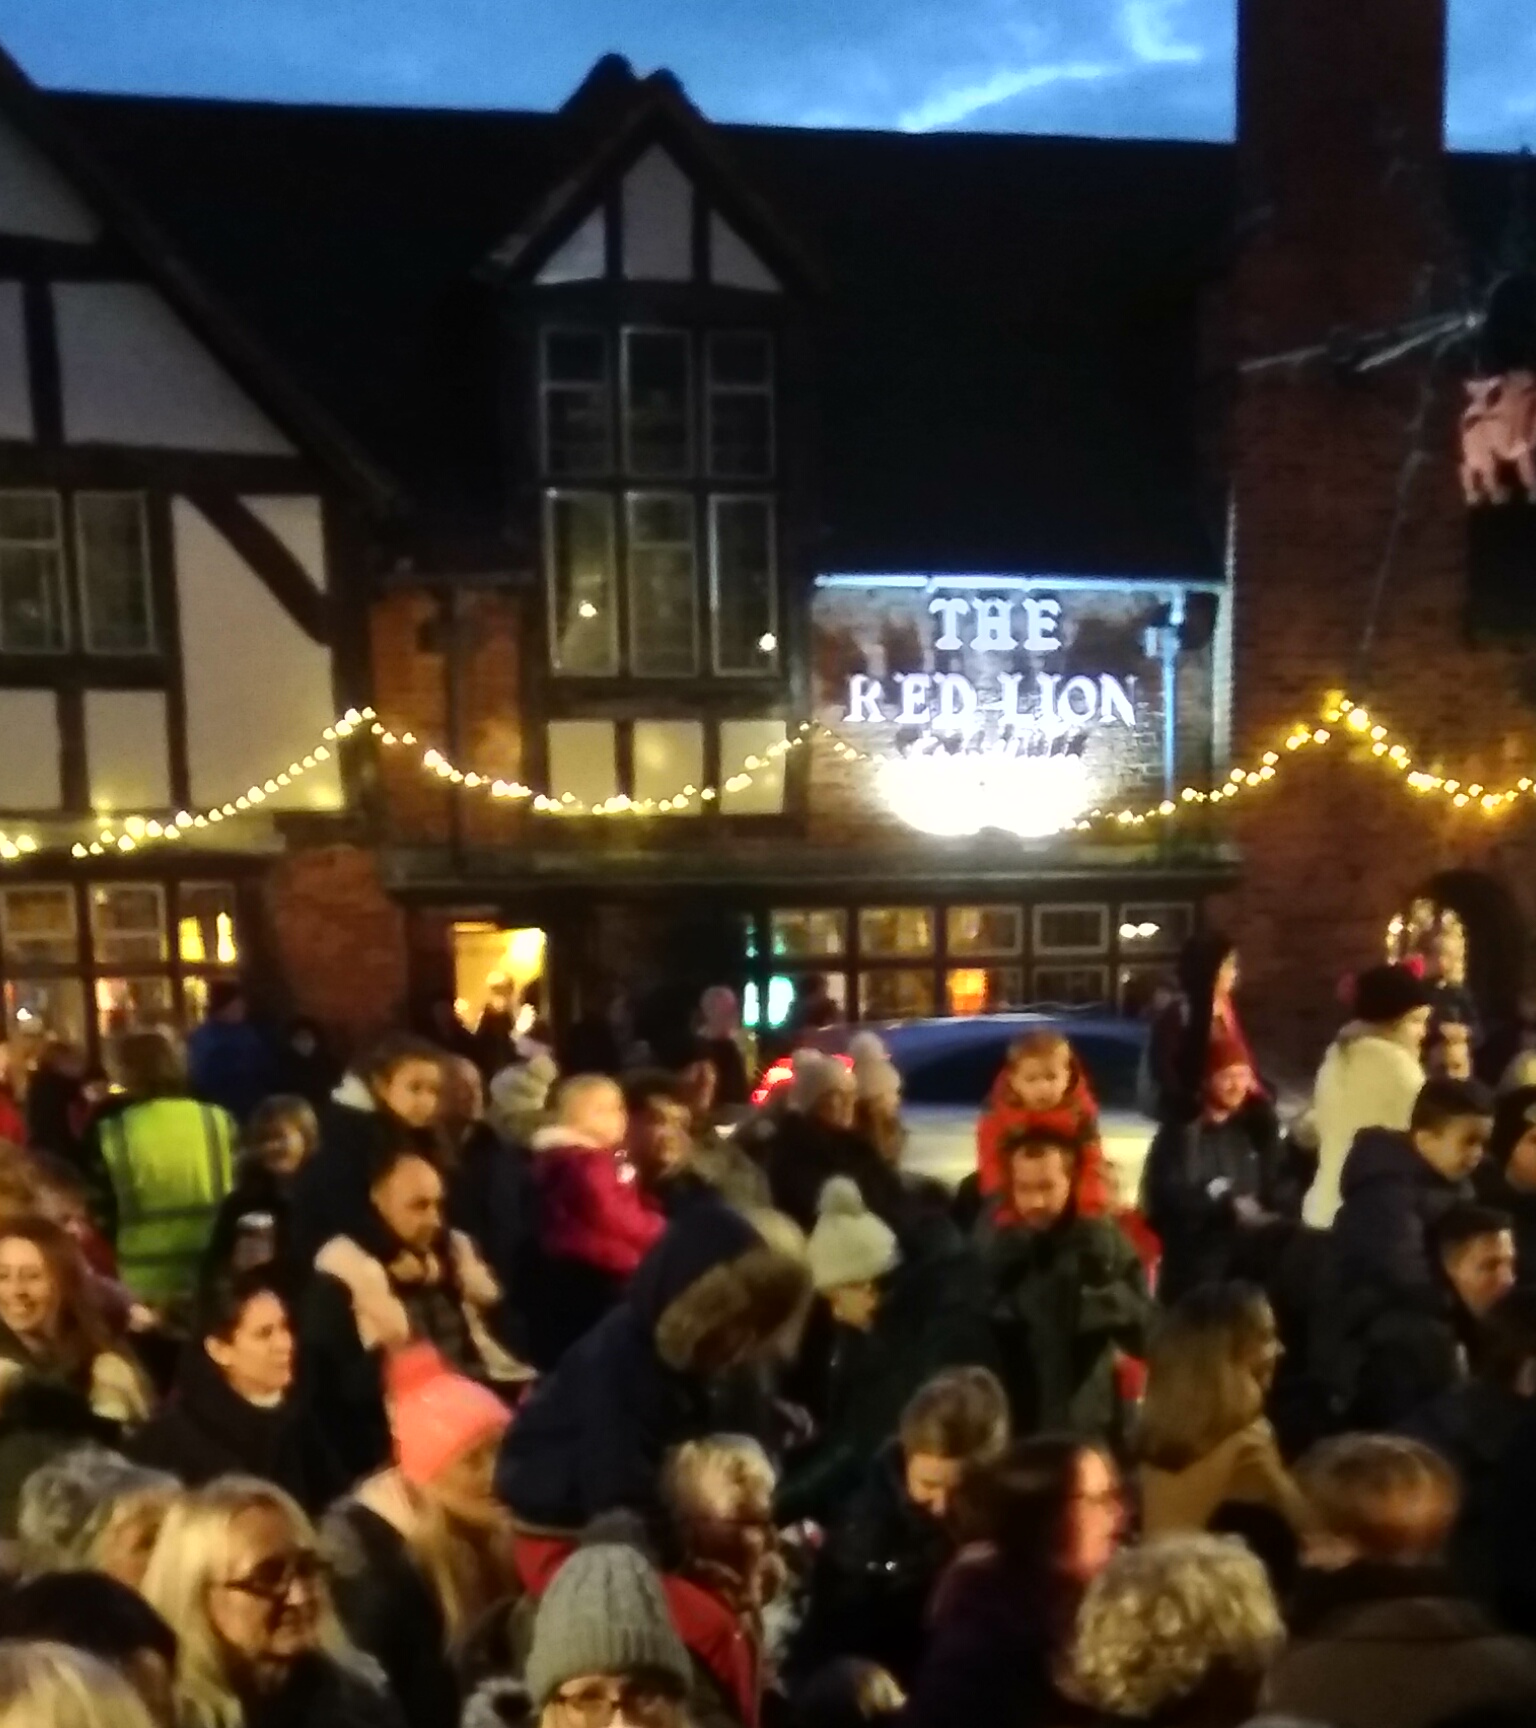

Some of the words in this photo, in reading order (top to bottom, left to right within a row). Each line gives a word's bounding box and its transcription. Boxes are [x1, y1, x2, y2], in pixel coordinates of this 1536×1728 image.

[928, 597, 1062, 651] THE
[843, 671, 978, 728] RED
[996, 671, 1139, 726] LION
